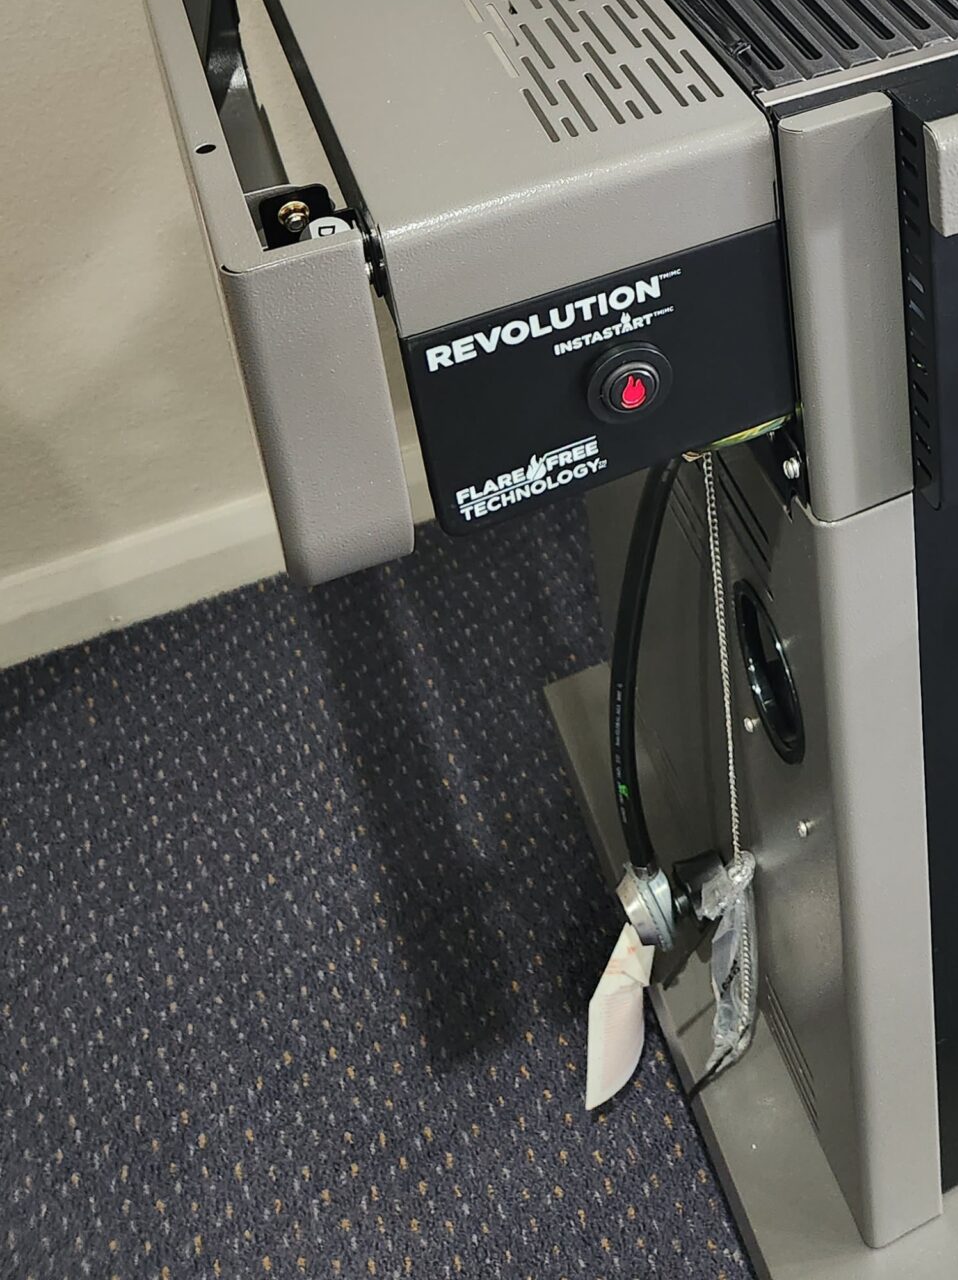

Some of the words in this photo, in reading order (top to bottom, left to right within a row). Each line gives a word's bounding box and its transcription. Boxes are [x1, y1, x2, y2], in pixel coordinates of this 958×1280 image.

[426, 275, 662, 372] REVOLUTION
[554, 311, 653, 356] INSTASTART
[456, 467, 528, 505] FLARE
[545, 440, 599, 472] FREE
[459, 458, 600, 521] TECHNOLOGY
